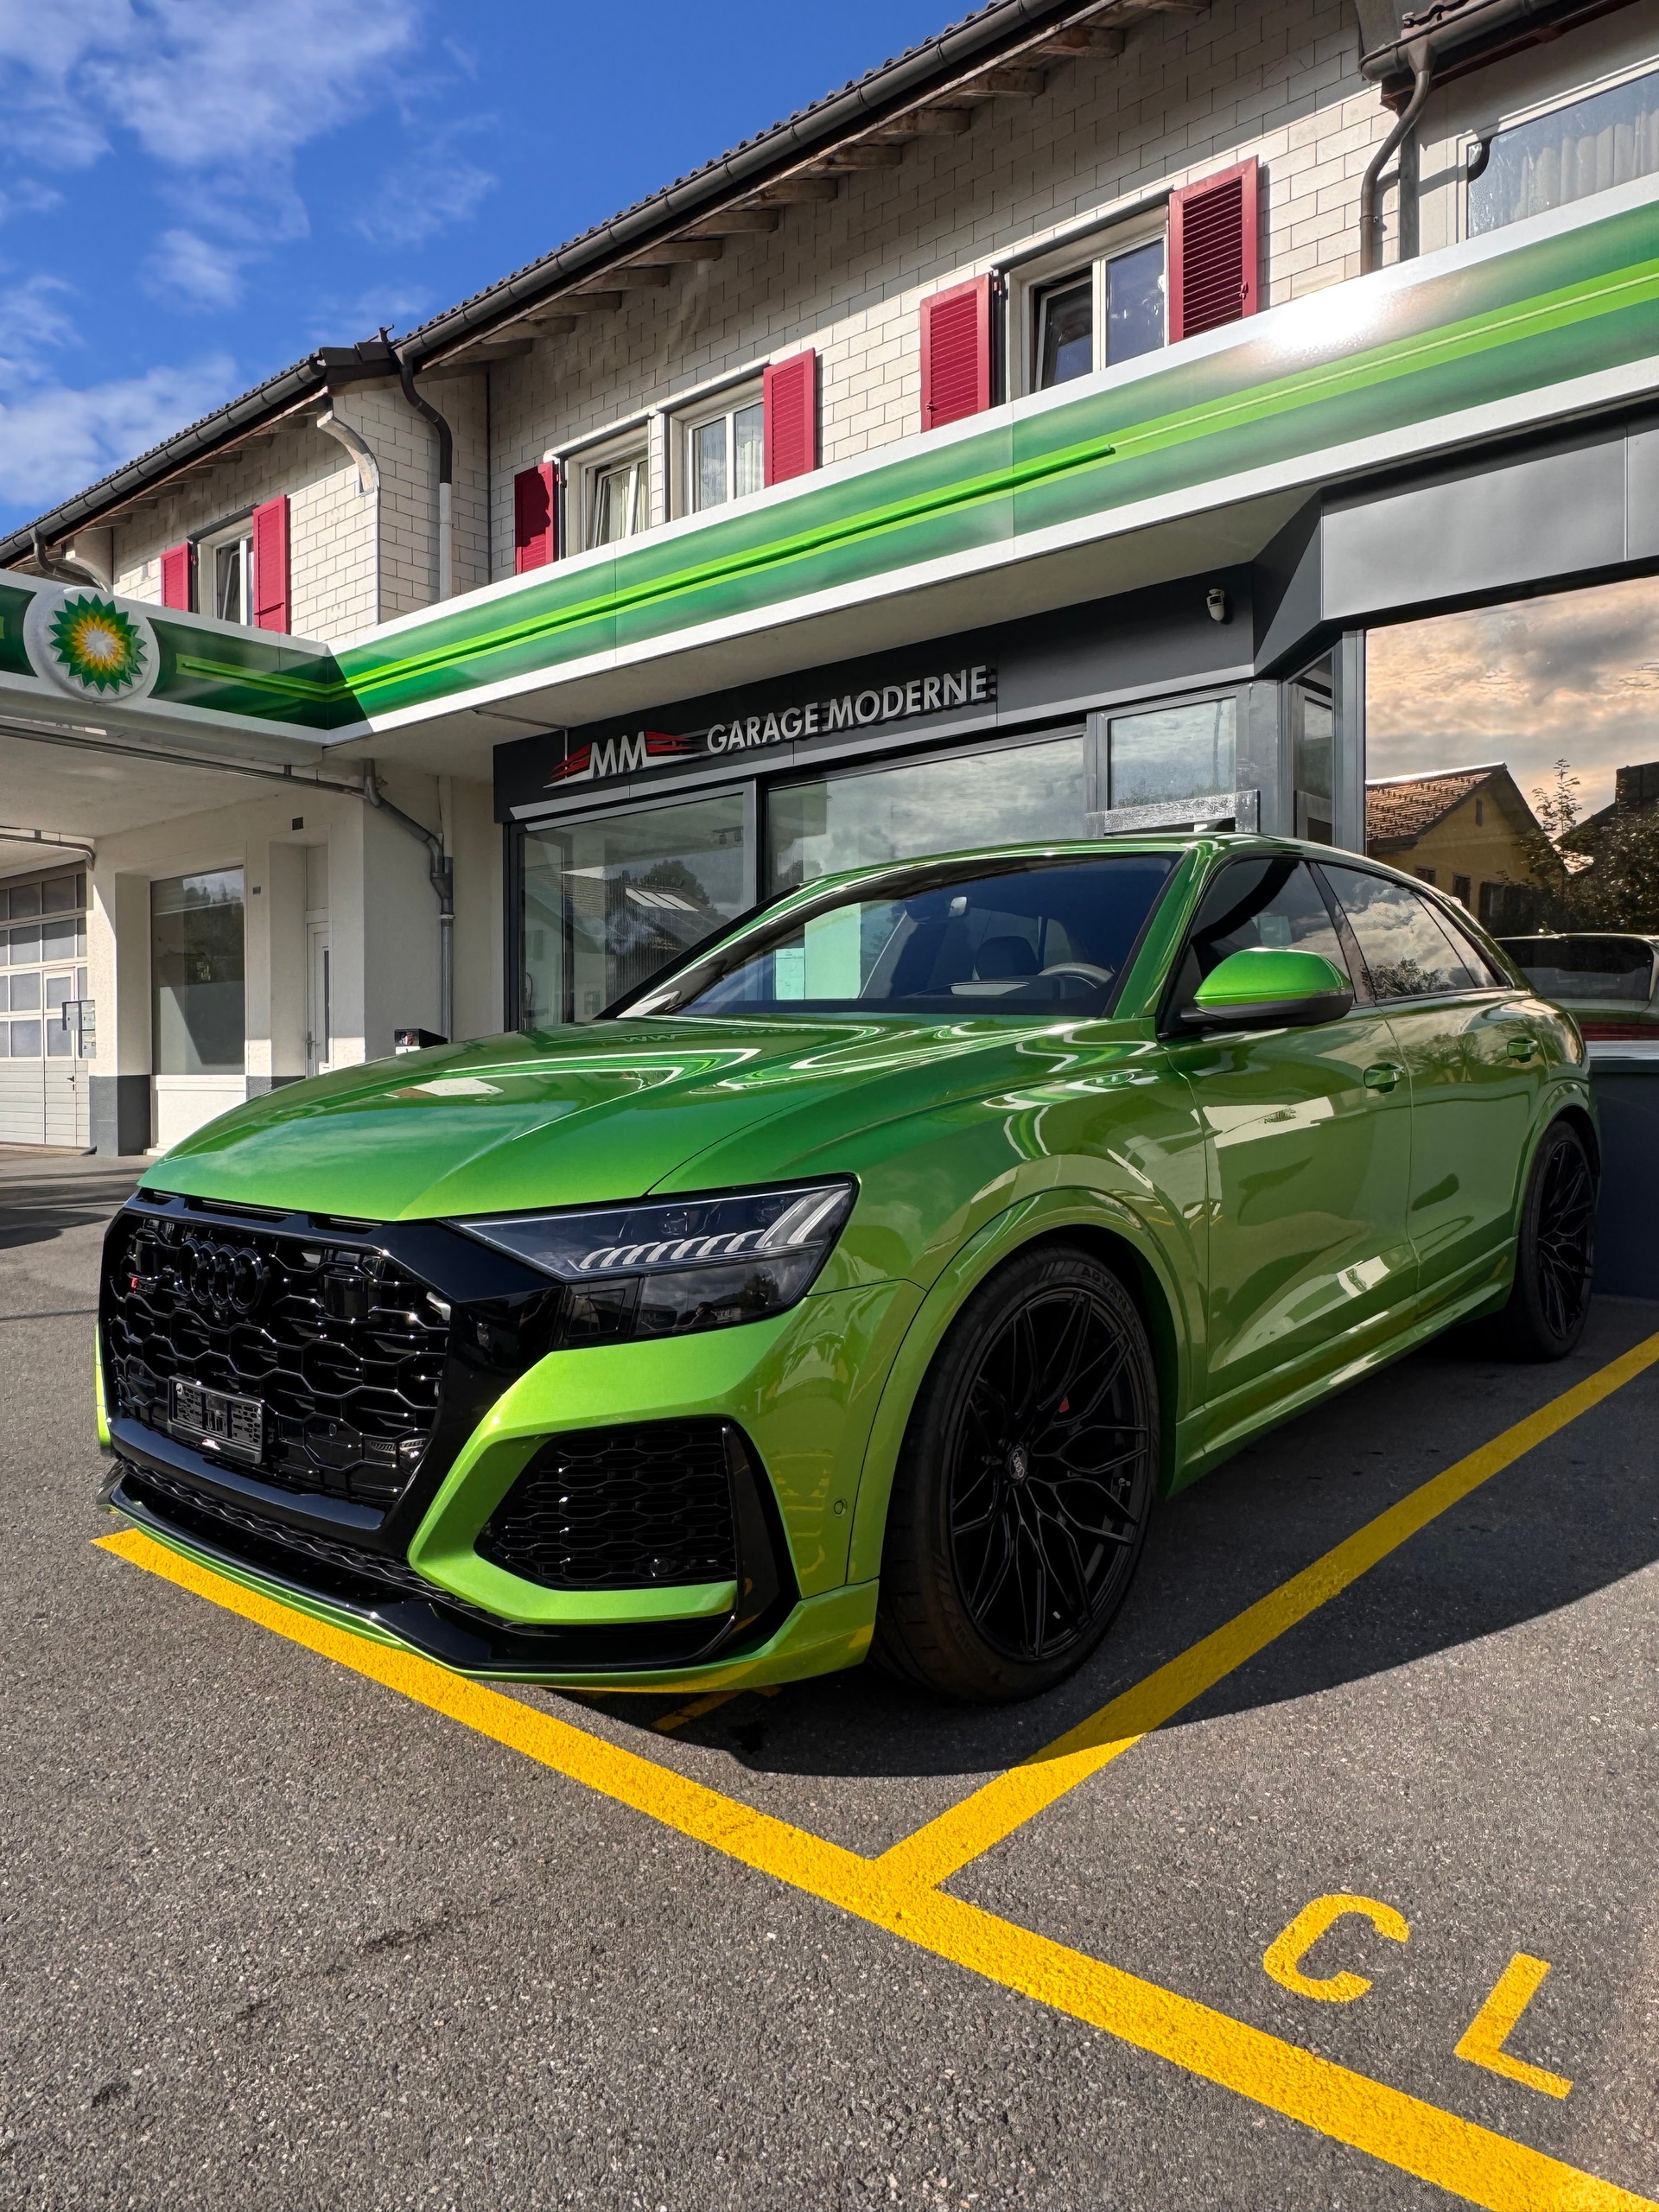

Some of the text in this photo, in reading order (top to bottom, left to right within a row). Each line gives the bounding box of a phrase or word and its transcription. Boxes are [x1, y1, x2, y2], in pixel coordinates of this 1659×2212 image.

[589, 664, 987, 779] MM GARAGE MODERNE
